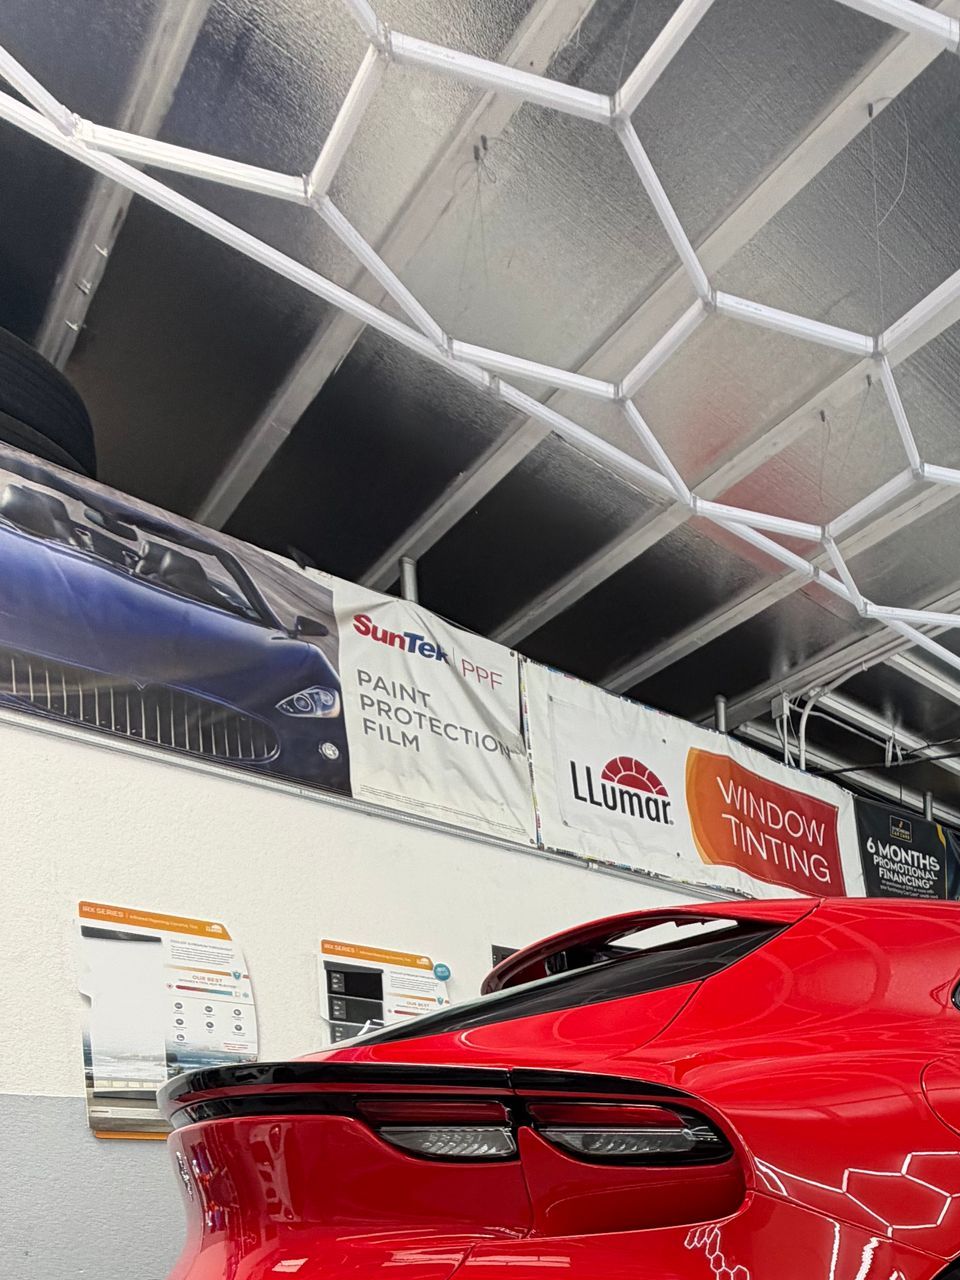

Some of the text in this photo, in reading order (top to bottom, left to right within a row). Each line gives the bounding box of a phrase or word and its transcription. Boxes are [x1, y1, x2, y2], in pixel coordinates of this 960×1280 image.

[353, 614, 503, 690] SunTek PPF
[357, 669, 431, 708] PAINT
[360, 694, 512, 760] PROTECTION
[363, 717, 420, 752] FILM
[716, 776, 825, 846] WINDOW
[722, 813, 831, 883] TINTING
[866, 837, 940, 871] 6 MONTHS
[873, 855, 938, 880] PROMOTIONAL
[96, 908, 124, 918] SERIES
